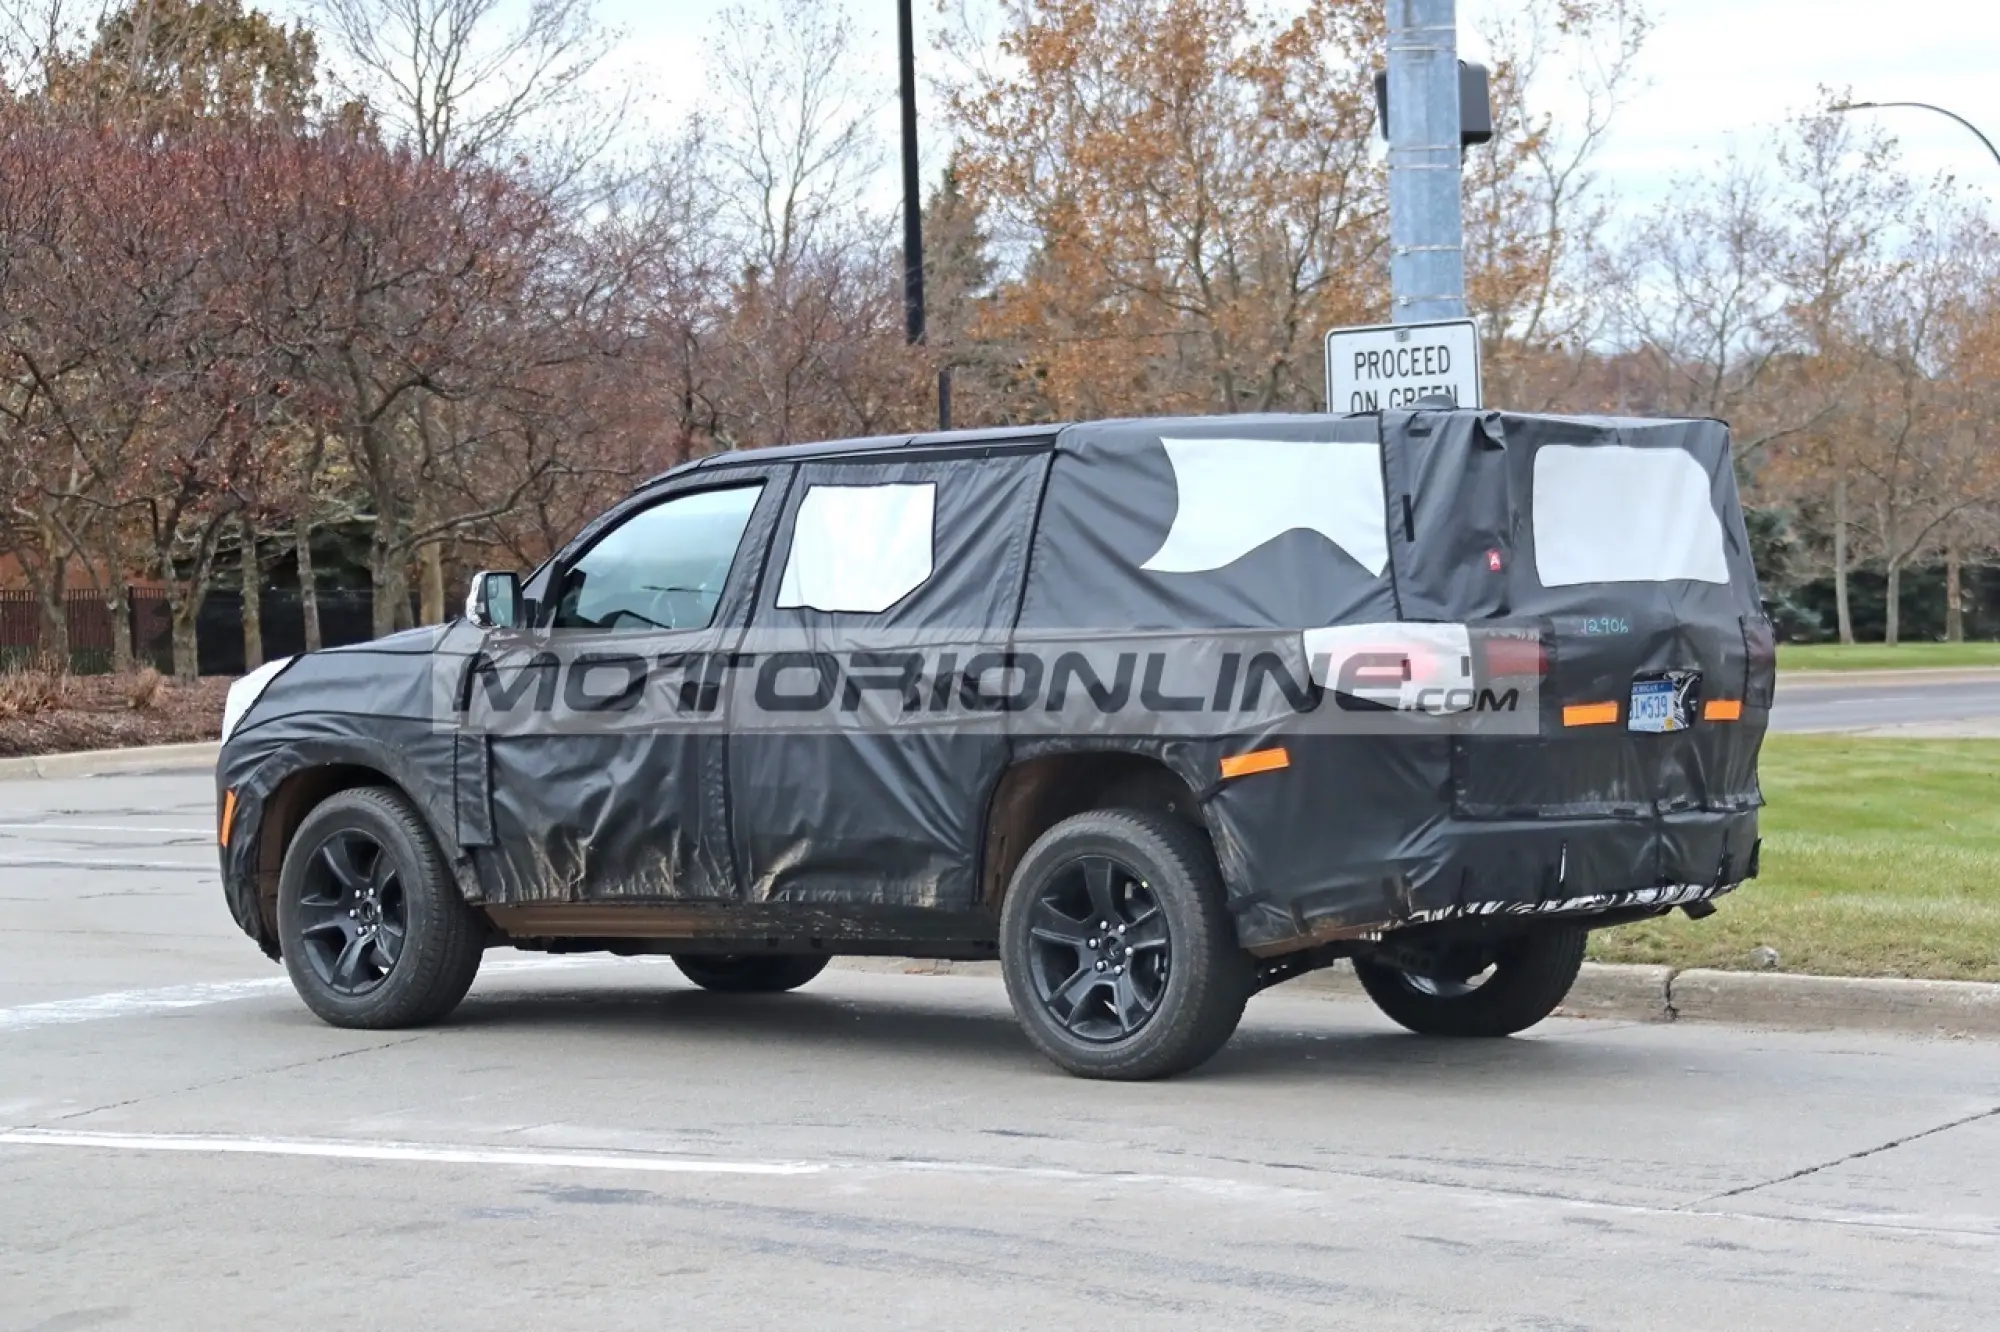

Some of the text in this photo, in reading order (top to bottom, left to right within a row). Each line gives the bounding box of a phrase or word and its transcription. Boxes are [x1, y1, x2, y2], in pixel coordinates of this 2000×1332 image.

[1354, 345, 1450, 380] PROCEED
[1582, 617, 1629, 635] 12906
[1630, 696, 1668, 719] 1M539
